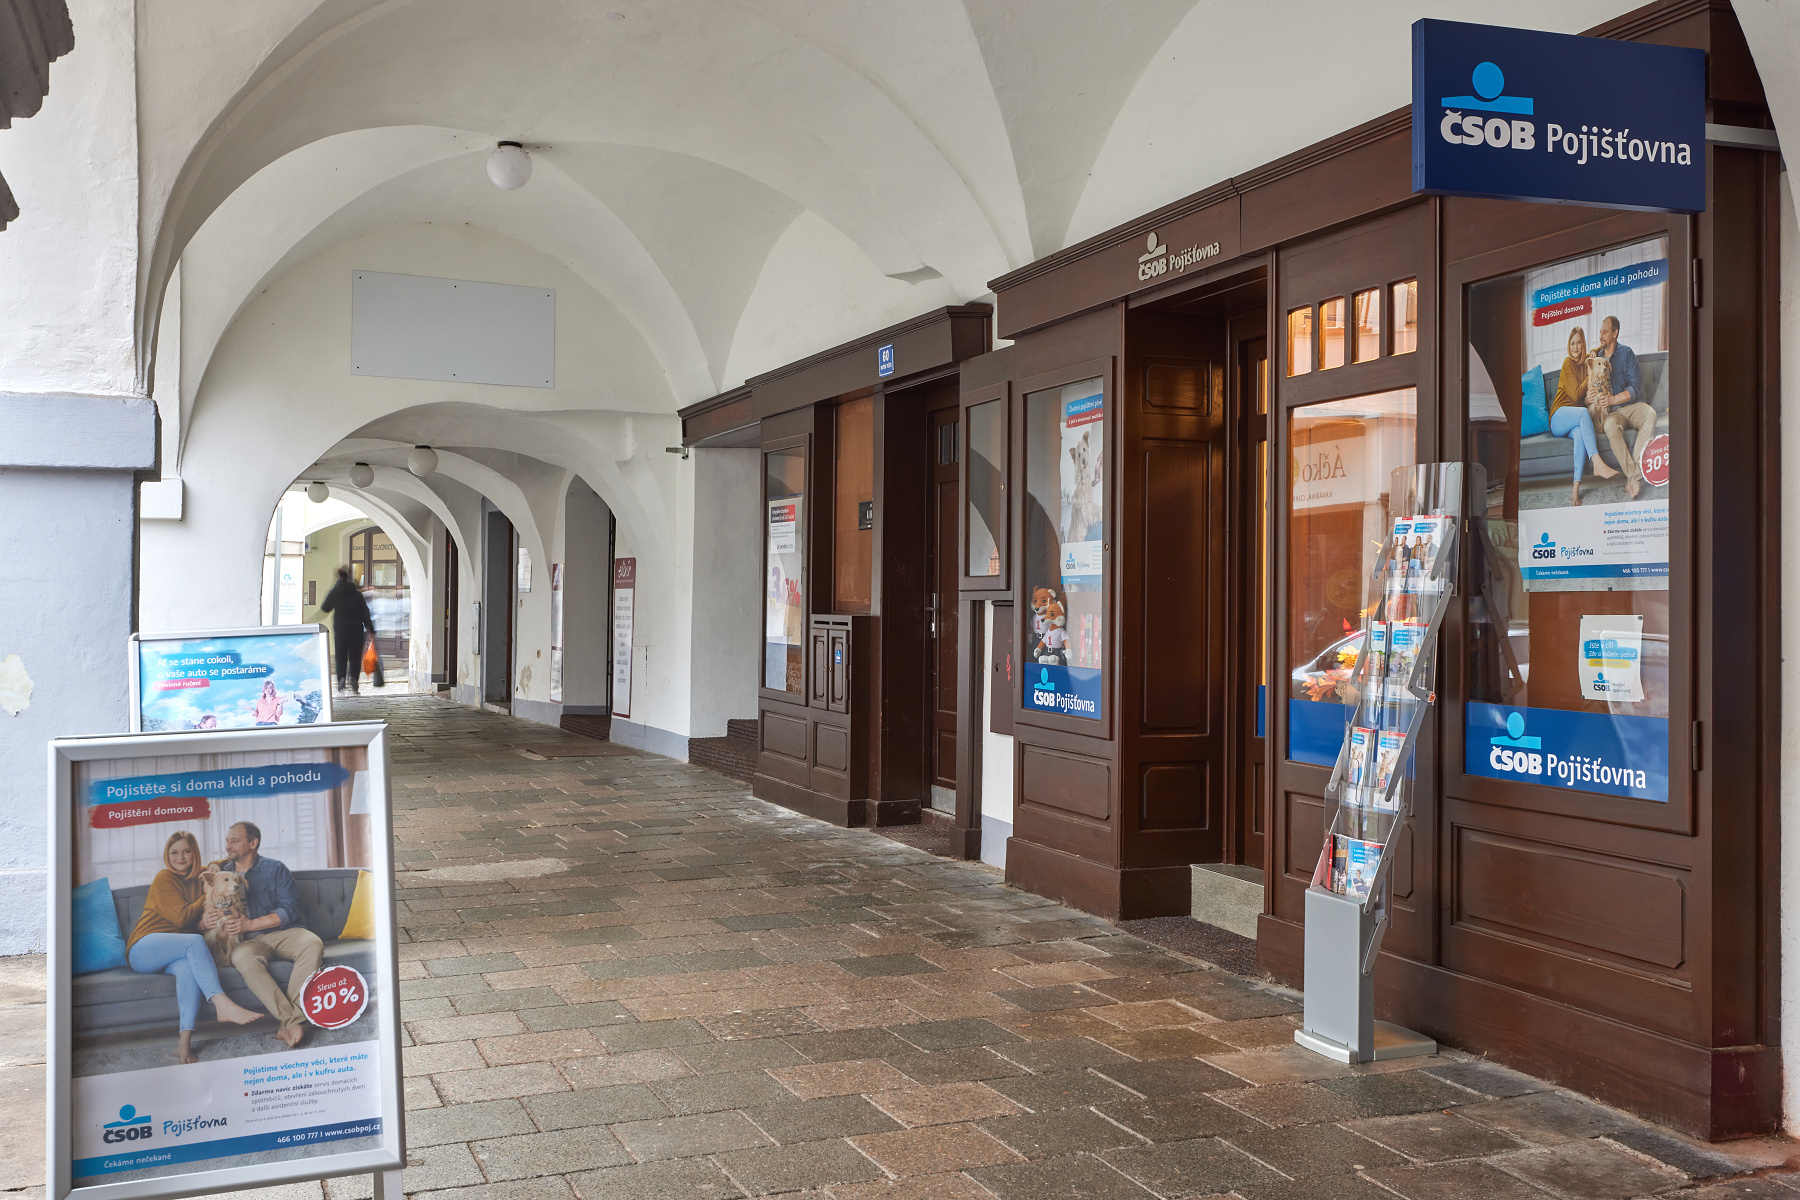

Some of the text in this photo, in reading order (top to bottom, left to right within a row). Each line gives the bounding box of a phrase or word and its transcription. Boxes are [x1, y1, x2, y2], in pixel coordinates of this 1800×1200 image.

[1440, 109, 1692, 165] ČSOB Pojišťovna
[1138, 242, 1220, 281] ČSOB Pojišťovna
[1540, 266, 1659, 303] Pojistěte si doma klid a pohodu
[1532, 545, 1594, 560] ČSOB Pojišťovna
[181, 657, 205, 666] stane
[206, 655, 234, 665] cokoli,
[157, 665, 267, 679] o vaše auto se postaráme
[1033, 689, 1095, 713] ČSOB Pojišťovna
[1489, 746, 1646, 789] ČSOB Pojišťovna
[107, 770, 321, 799] Pojistěte si doma klid a pohodu
[108, 805, 193, 820] Pojištění domova
[317, 978, 347, 992] Sleva až
[244, 1053, 369, 1076] Pojistíme všechny věci, které máte
[244, 1077, 264, 1086] nejen
[266, 1074, 290, 1083] doma,
[291, 1072, 302, 1080] ale
[315, 1067, 335, 1076] kufru
[337, 1065, 356, 1073] auta.
[251, 1088, 274, 1096] Zdarma
[275, 1086, 291, 1094] navíc
[292, 1083, 312, 1092] získáte
[103, 1115, 227, 1144] ČSOB Pojišťovna
[277, 1135, 290, 1144] 466
[293, 1133, 306, 1141] 100
[307, 1131, 319, 1140] 777
[324, 1123, 381, 1138] www.csobpoj.cz
[104, 1153, 171, 1168] Čekáme nečekané
